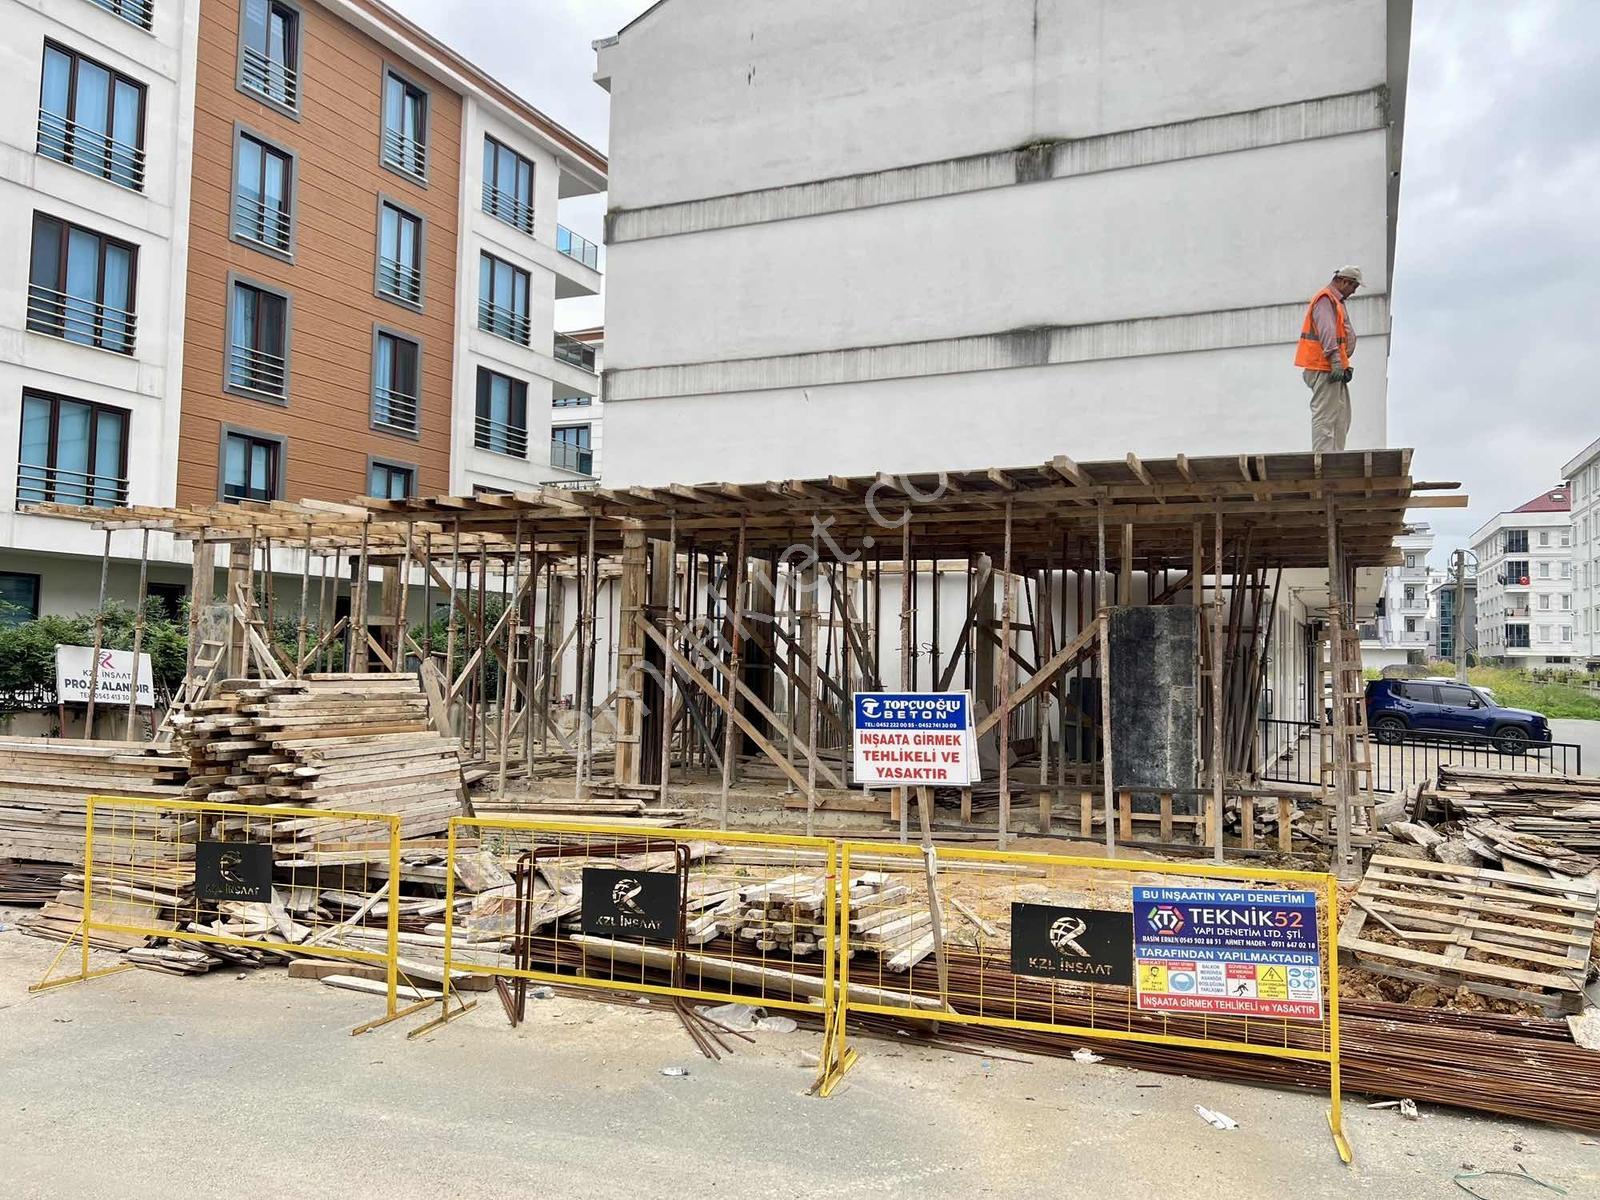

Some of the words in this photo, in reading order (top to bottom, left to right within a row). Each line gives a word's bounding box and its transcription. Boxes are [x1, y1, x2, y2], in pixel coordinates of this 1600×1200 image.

[883, 698, 961, 712] TOPÇUOĞLU
[884, 711, 947, 720] BETON
[860, 730, 910, 748] İNŞAATA
[913, 732, 962, 746] GİRMEK
[863, 748, 936, 763] TEHLİKELİ
[941, 752, 960, 763] VE
[876, 767, 948, 779] YASAKTIR
[1142, 890, 1158, 899] BU
[1162, 889, 1215, 902] İNŞAATIN
[1218, 893, 1244, 902] YAPI
[1248, 894, 1305, 904] DENETİMİ
[1193, 927, 1214, 935] YAPI
[1217, 928, 1261, 937] DENETİM
[1264, 930, 1283, 938] LTD.
[1286, 930, 1304, 940] ŞTİ.
[1140, 948, 1214, 960] TARAFINDAN
[1216, 952, 1314, 964] YAPILMAKTADIR
[1028, 957, 1056, 970] KZL
[1144, 995, 1179, 1007] İNŞAATA
[1180, 997, 1212, 1008] GİRMEK
[1215, 1000, 1258, 1011] TEHLİKELİ
[1272, 1004, 1315, 1015] YASAKTIR
